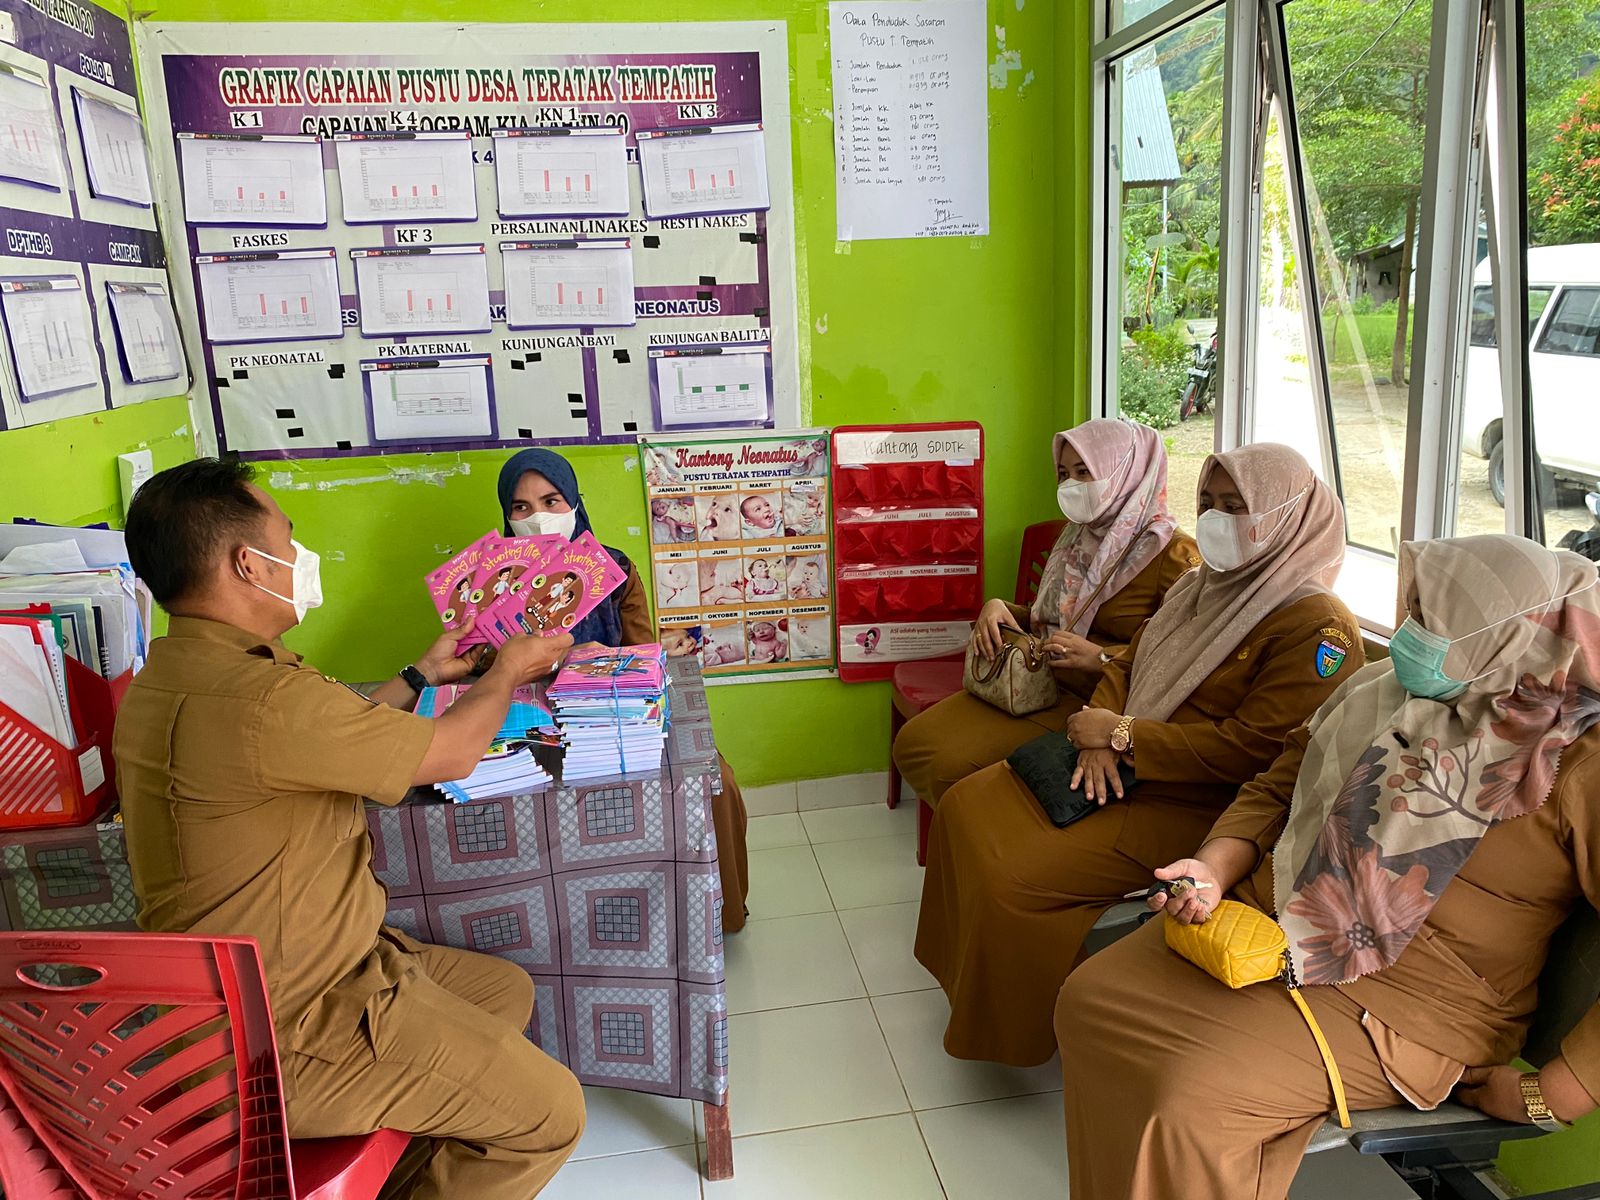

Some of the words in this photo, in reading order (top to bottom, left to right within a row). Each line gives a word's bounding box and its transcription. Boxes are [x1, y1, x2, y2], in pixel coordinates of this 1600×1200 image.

[80, 8, 95, 39] 20
[842, 12, 867, 26] Data
[872, 12, 910, 27] Penduduk
[916, 15, 945, 27] Sasaran
[901, 35, 934, 48] Tempatih
[79, 53, 105, 82] POLIO
[221, 68, 302, 105] GRAFIK
[306, 68, 391, 105] CAPAIAN
[398, 68, 460, 103] PUSTU
[466, 69, 519, 102] DESA
[523, 67, 614, 102] TERATAK
[617, 66, 716, 100] TEMPATIH
[232, 113, 247, 127] K
[389, 111, 403, 125] K
[405, 111, 418, 125] 4
[540, 108, 564, 122] KN
[567, 108, 578, 121] 1
[680, 105, 703, 119] KN
[706, 105, 717, 118] 3
[301, 116, 387, 138] CAPAIAN
[660, 217, 701, 230] RESTI
[703, 214, 749, 229] NAKES
[6, 229, 44, 254] DPTHB
[42, 234, 53, 255] 3
[232, 233, 288, 249] FASKES
[396, 229, 419, 243] KF
[424, 228, 433, 242] 3
[108, 242, 142, 263] CAMPAK
[634, 299, 720, 315] NEONATUS
[501, 336, 584, 351] KUNJUNGAN
[587, 335, 616, 347] BAYI
[649, 331, 720, 346] KUNJUNGAN
[720, 329, 769, 342] BALITA
[378, 346, 398, 357] PK
[399, 342, 471, 356] MATERNAL
[230, 356, 249, 368] PK
[251, 352, 324, 367] NEONATAL
[863, 440, 919, 459] Kantong
[675, 448, 735, 471] Kantong
[737, 445, 798, 466] Neonatus
[683, 474, 712, 482] PUSTU
[711, 471, 750, 481] TERATAK
[750, 469, 791, 478] TEMPATIH
[699, 484, 733, 492] FEBRUARI
[791, 543, 822, 551] AGUSTUS
[481, 546, 522, 571] Stunting
[563, 549, 598, 574] Stunting
[434, 560, 469, 596] Stunting
[660, 614, 699, 623] SEPTEMBER
